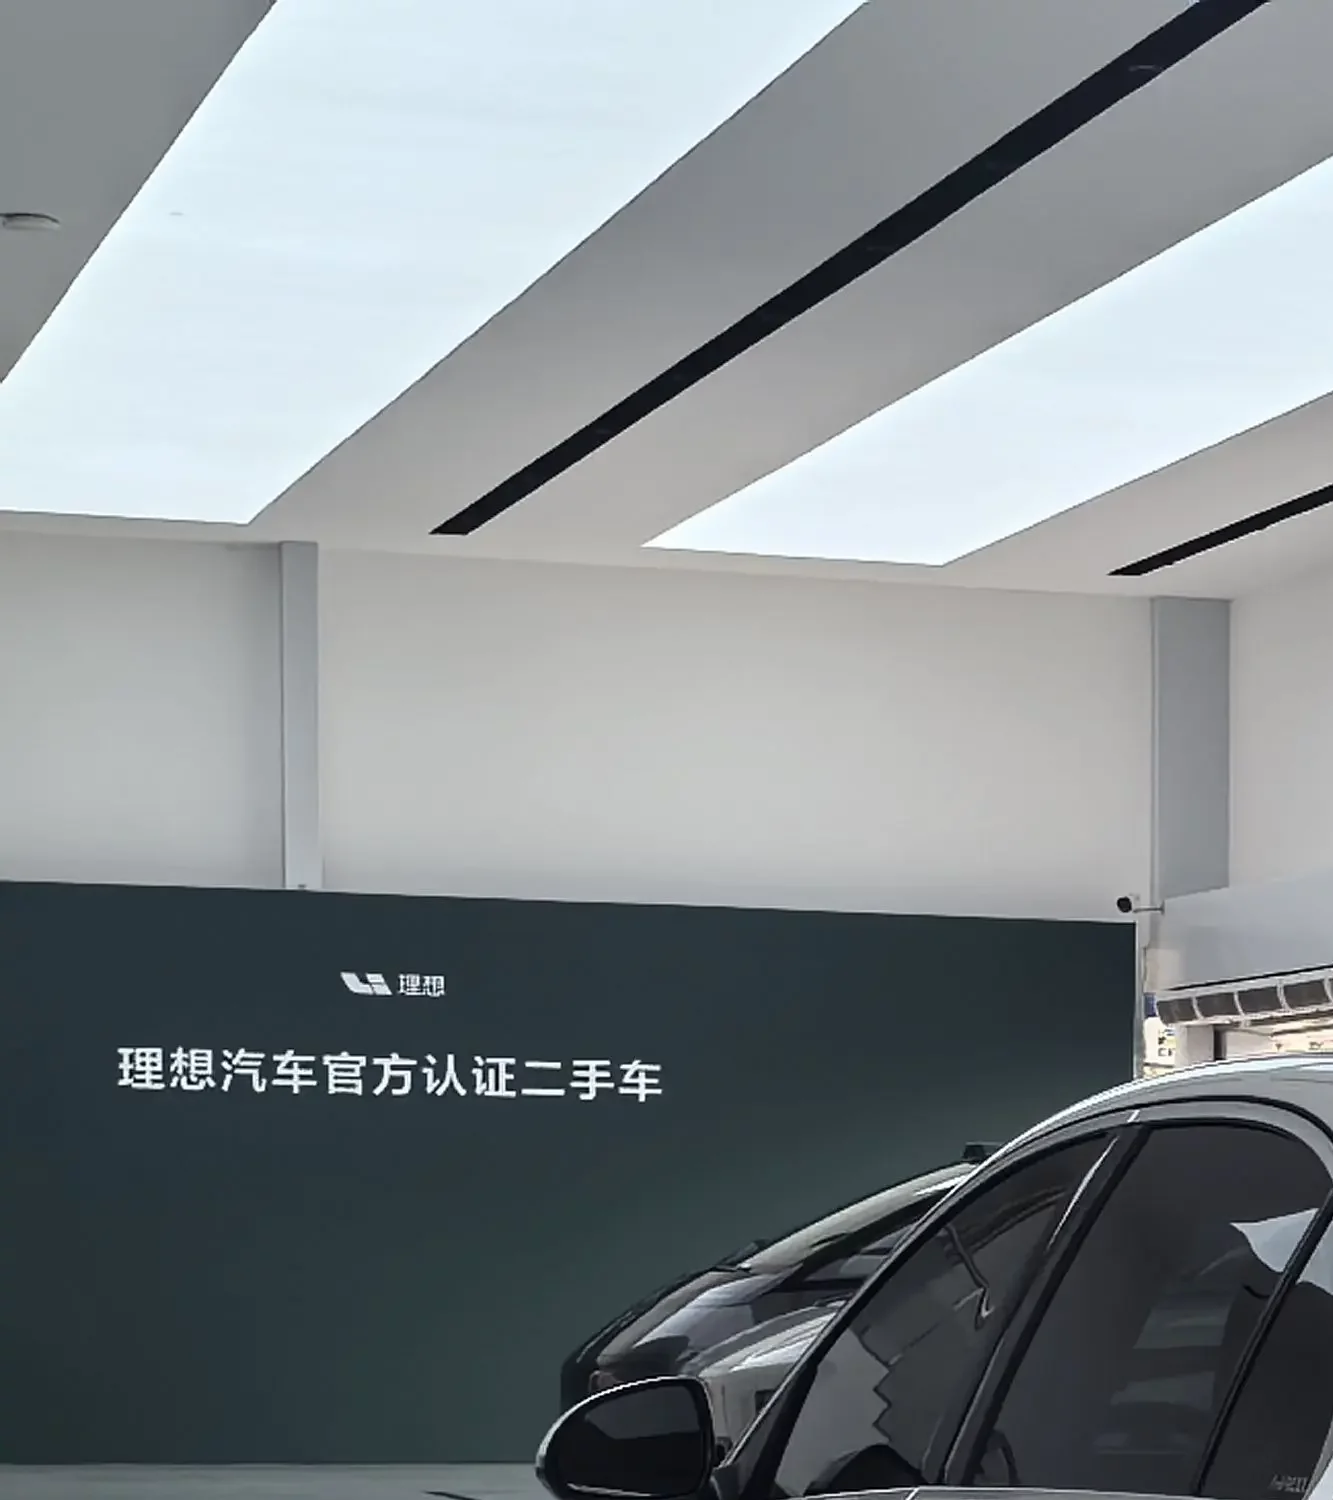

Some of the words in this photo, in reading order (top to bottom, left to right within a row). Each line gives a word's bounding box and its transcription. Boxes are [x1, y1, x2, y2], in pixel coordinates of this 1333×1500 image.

[398, 973, 445, 998] 理想
[117, 1047, 663, 1102] 理想汽车官方认证二手车
